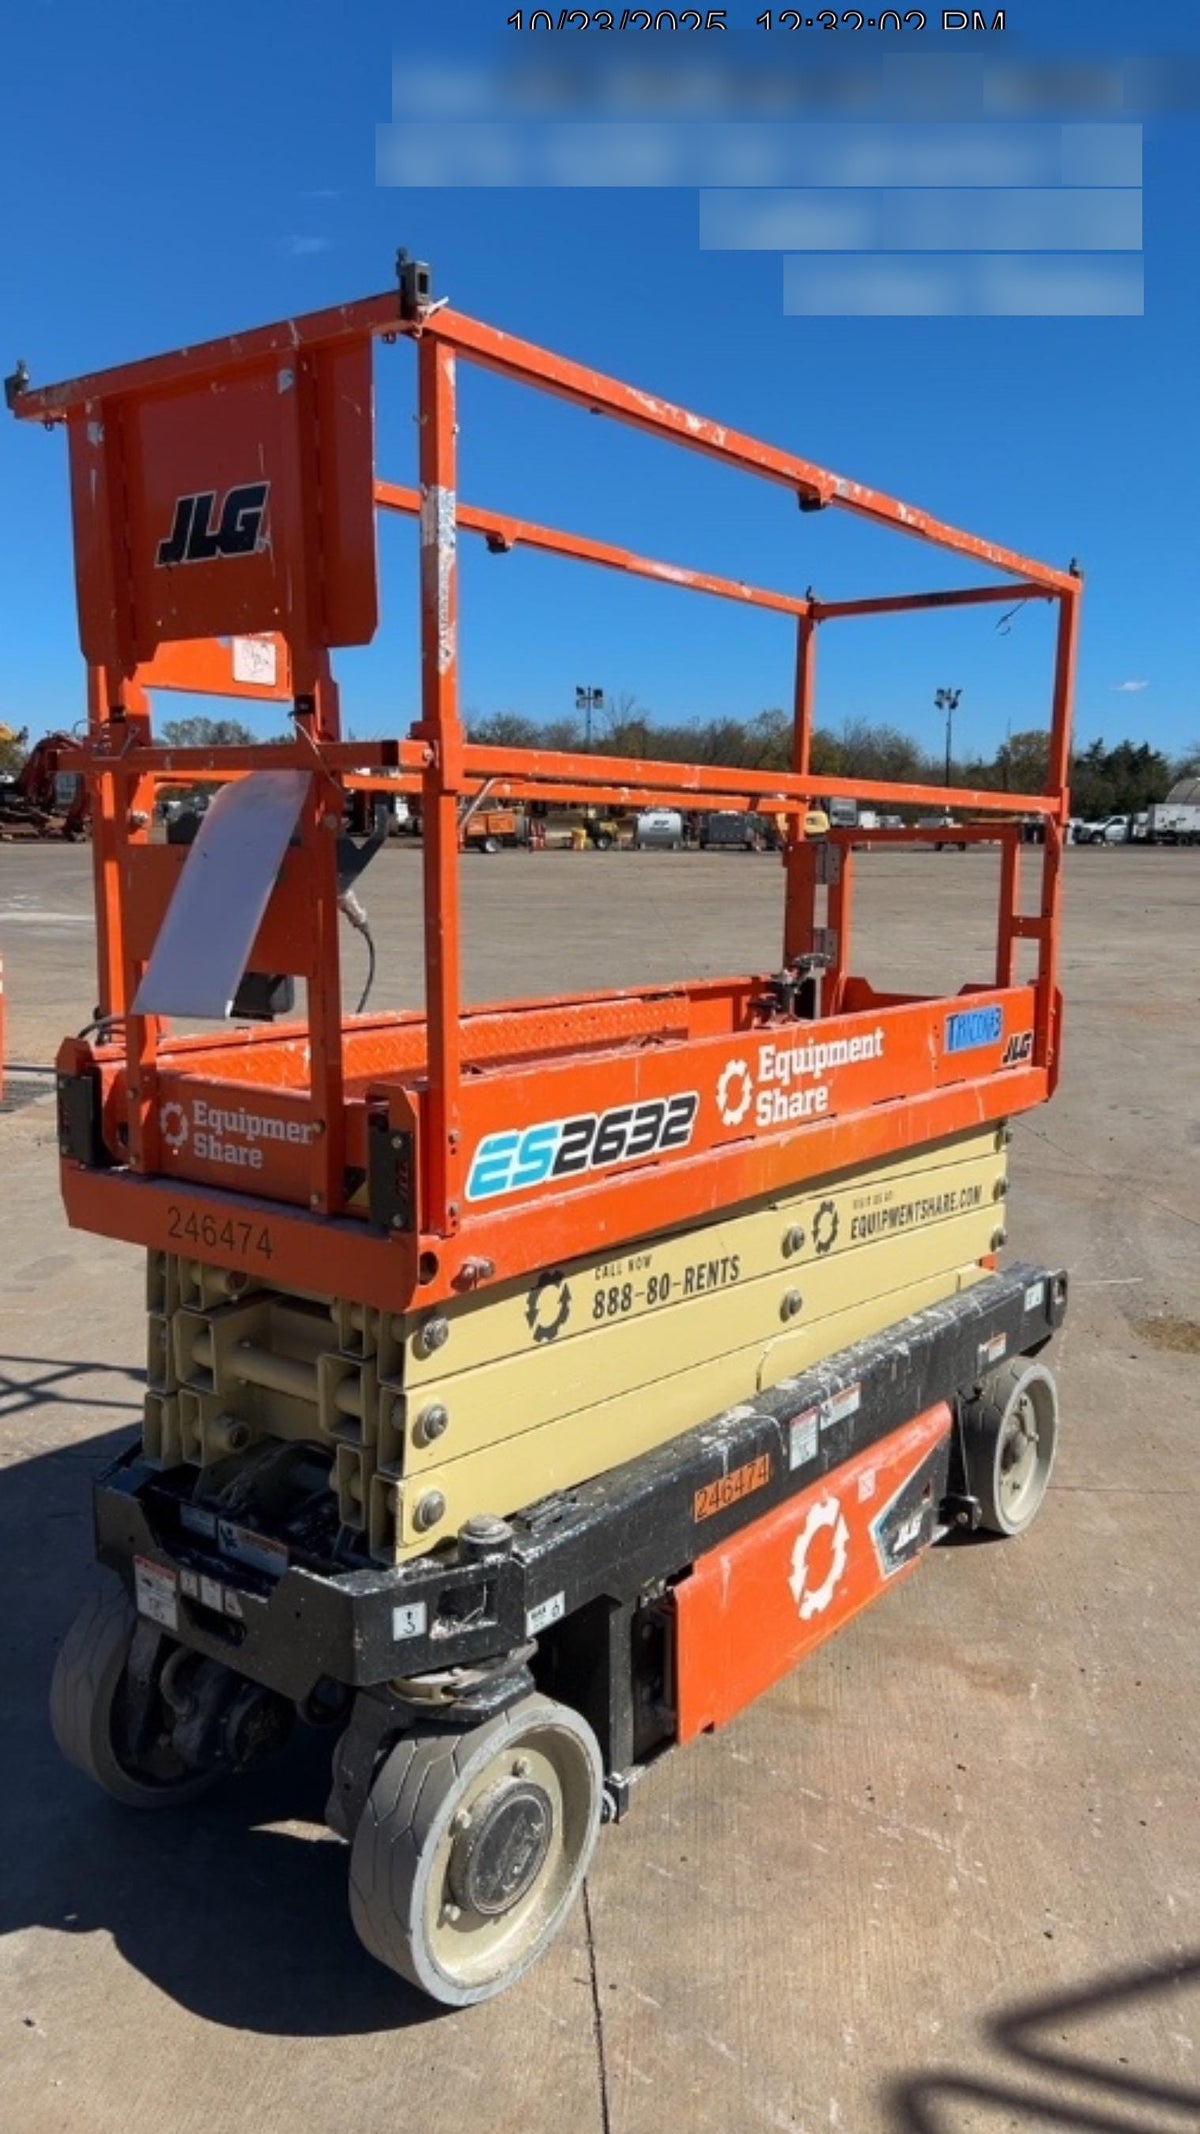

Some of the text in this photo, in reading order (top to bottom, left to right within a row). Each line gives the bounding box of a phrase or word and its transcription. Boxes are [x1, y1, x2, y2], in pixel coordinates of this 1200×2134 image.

[154, 480, 270, 568] JLG
[758, 1026, 884, 1086] Equipment
[1002, 1032, 1034, 1065] JLG
[756, 1085, 829, 1127] Share
[192, 1132, 263, 1169] Share
[465, 1090, 699, 1202] ES2632
[167, 1206, 274, 1260] 246474
[851, 1185, 983, 1241] EQUIPMENTSHARE.COM
[592, 1254, 741, 1320] 888-80-RENTS
[594, 1254, 653, 1281] CALL NOW
[697, 1456, 769, 1519] 246474
